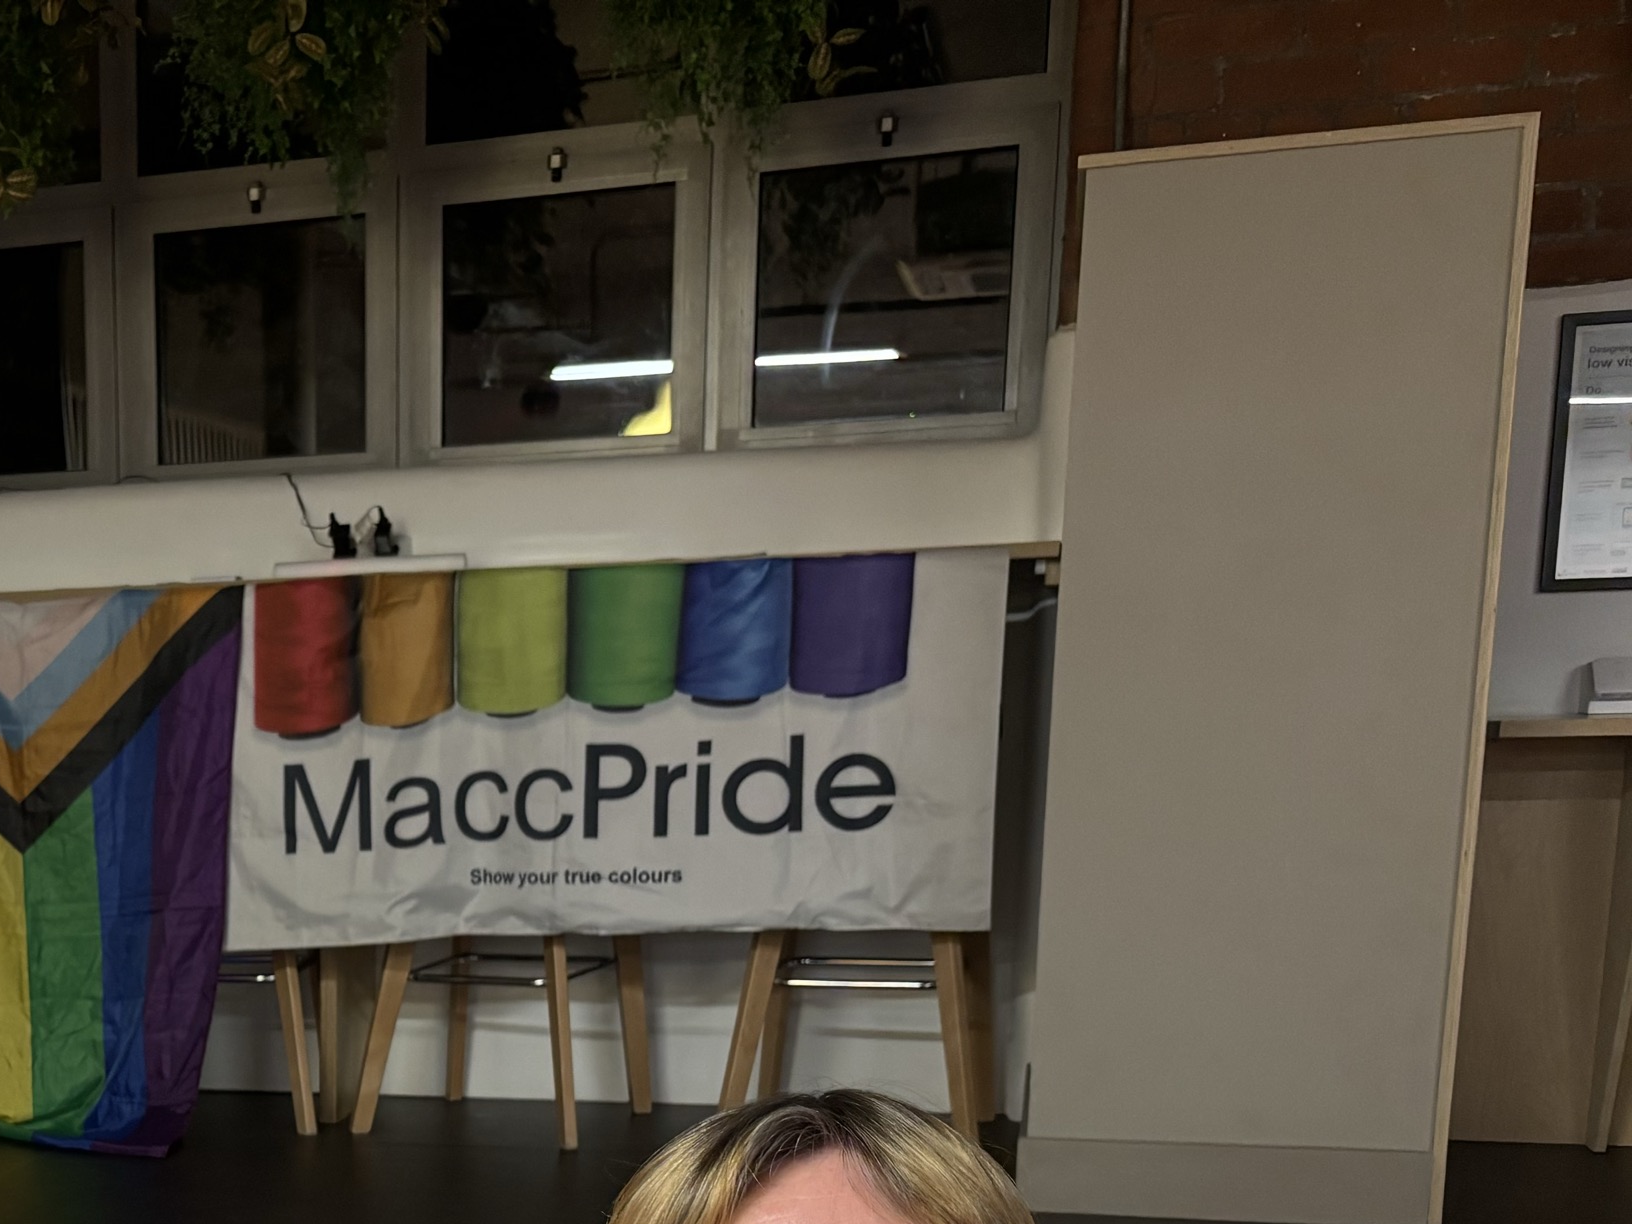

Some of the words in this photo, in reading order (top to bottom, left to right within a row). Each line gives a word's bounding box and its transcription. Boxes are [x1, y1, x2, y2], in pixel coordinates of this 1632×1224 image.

[1587, 358, 1613, 369] low
[282, 733, 897, 855] MaccPride
[470, 868, 515, 886] Show
[517, 871, 559, 888] your
[563, 868, 602, 885] true
[607, 867, 683, 885] colours
